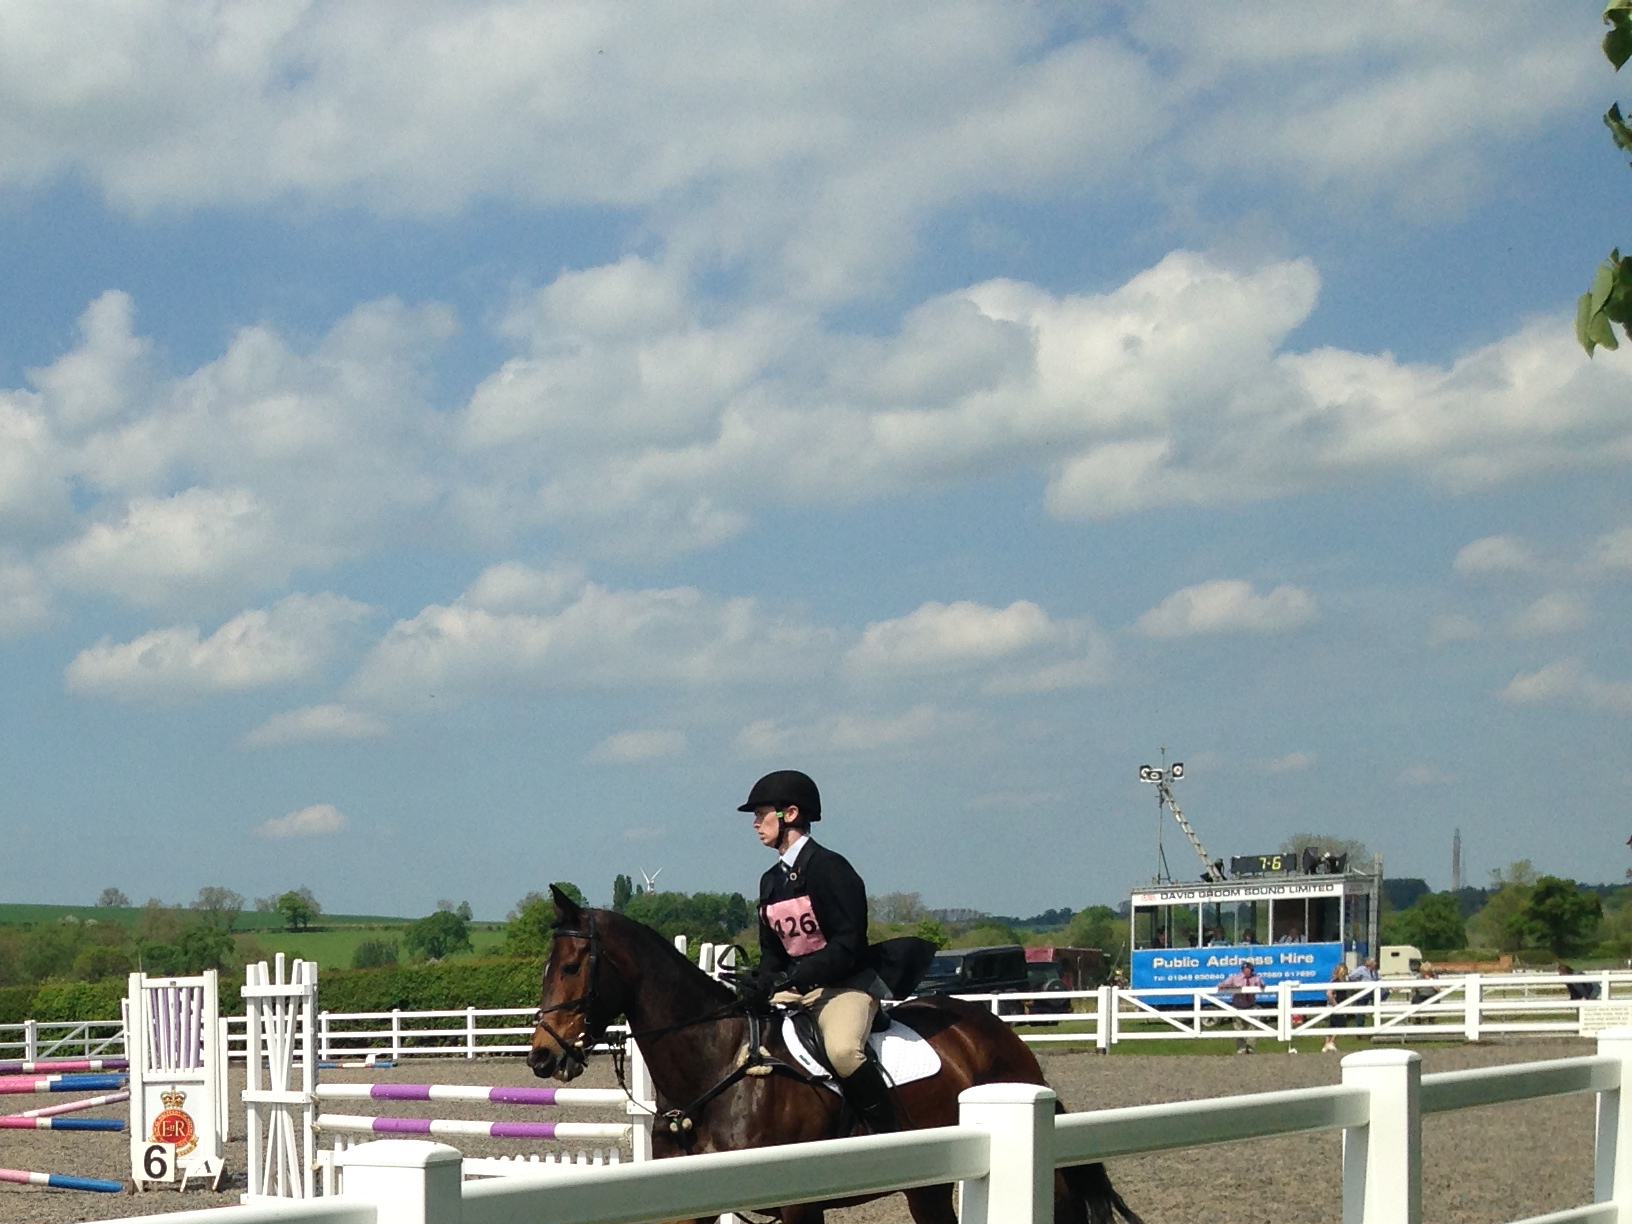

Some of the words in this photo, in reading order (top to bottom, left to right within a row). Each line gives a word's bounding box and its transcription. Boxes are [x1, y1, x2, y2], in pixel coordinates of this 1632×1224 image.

[1160, 891, 1195, 900] DAVID
[1198, 889, 1240, 899] GROOM
[1244, 885, 1285, 896] SOUND
[1289, 884, 1334, 894] LIMITED
[774, 912, 817, 939] 426
[1152, 956, 1200, 969] Public
[1206, 954, 1274, 967] Address
[1280, 952, 1314, 964] Hire
[144, 1144, 168, 1180] 6
